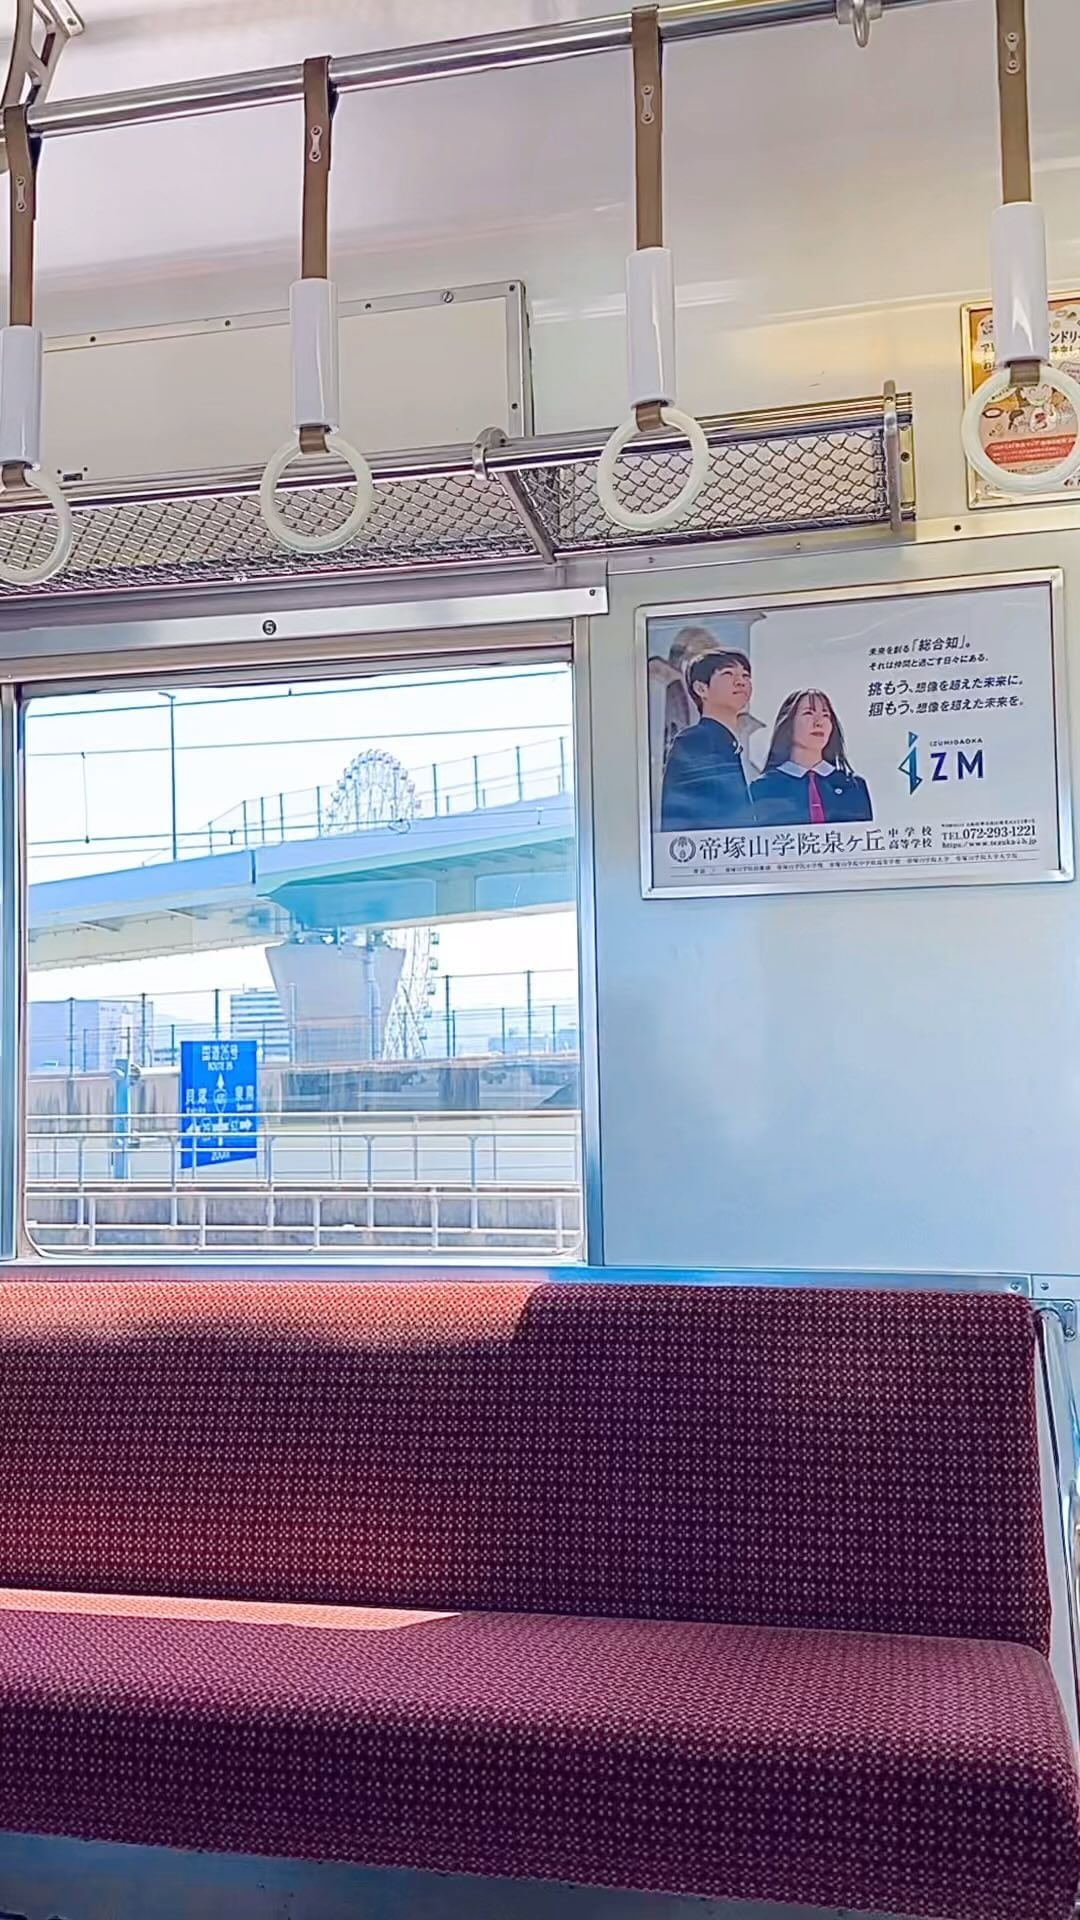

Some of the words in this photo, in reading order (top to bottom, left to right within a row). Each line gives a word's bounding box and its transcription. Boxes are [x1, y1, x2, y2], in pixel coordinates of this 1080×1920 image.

[868, 675, 1023, 697] 挑もう、想像を超えた未来に。
[930, 738, 983, 746] IZUMIGAOKA
